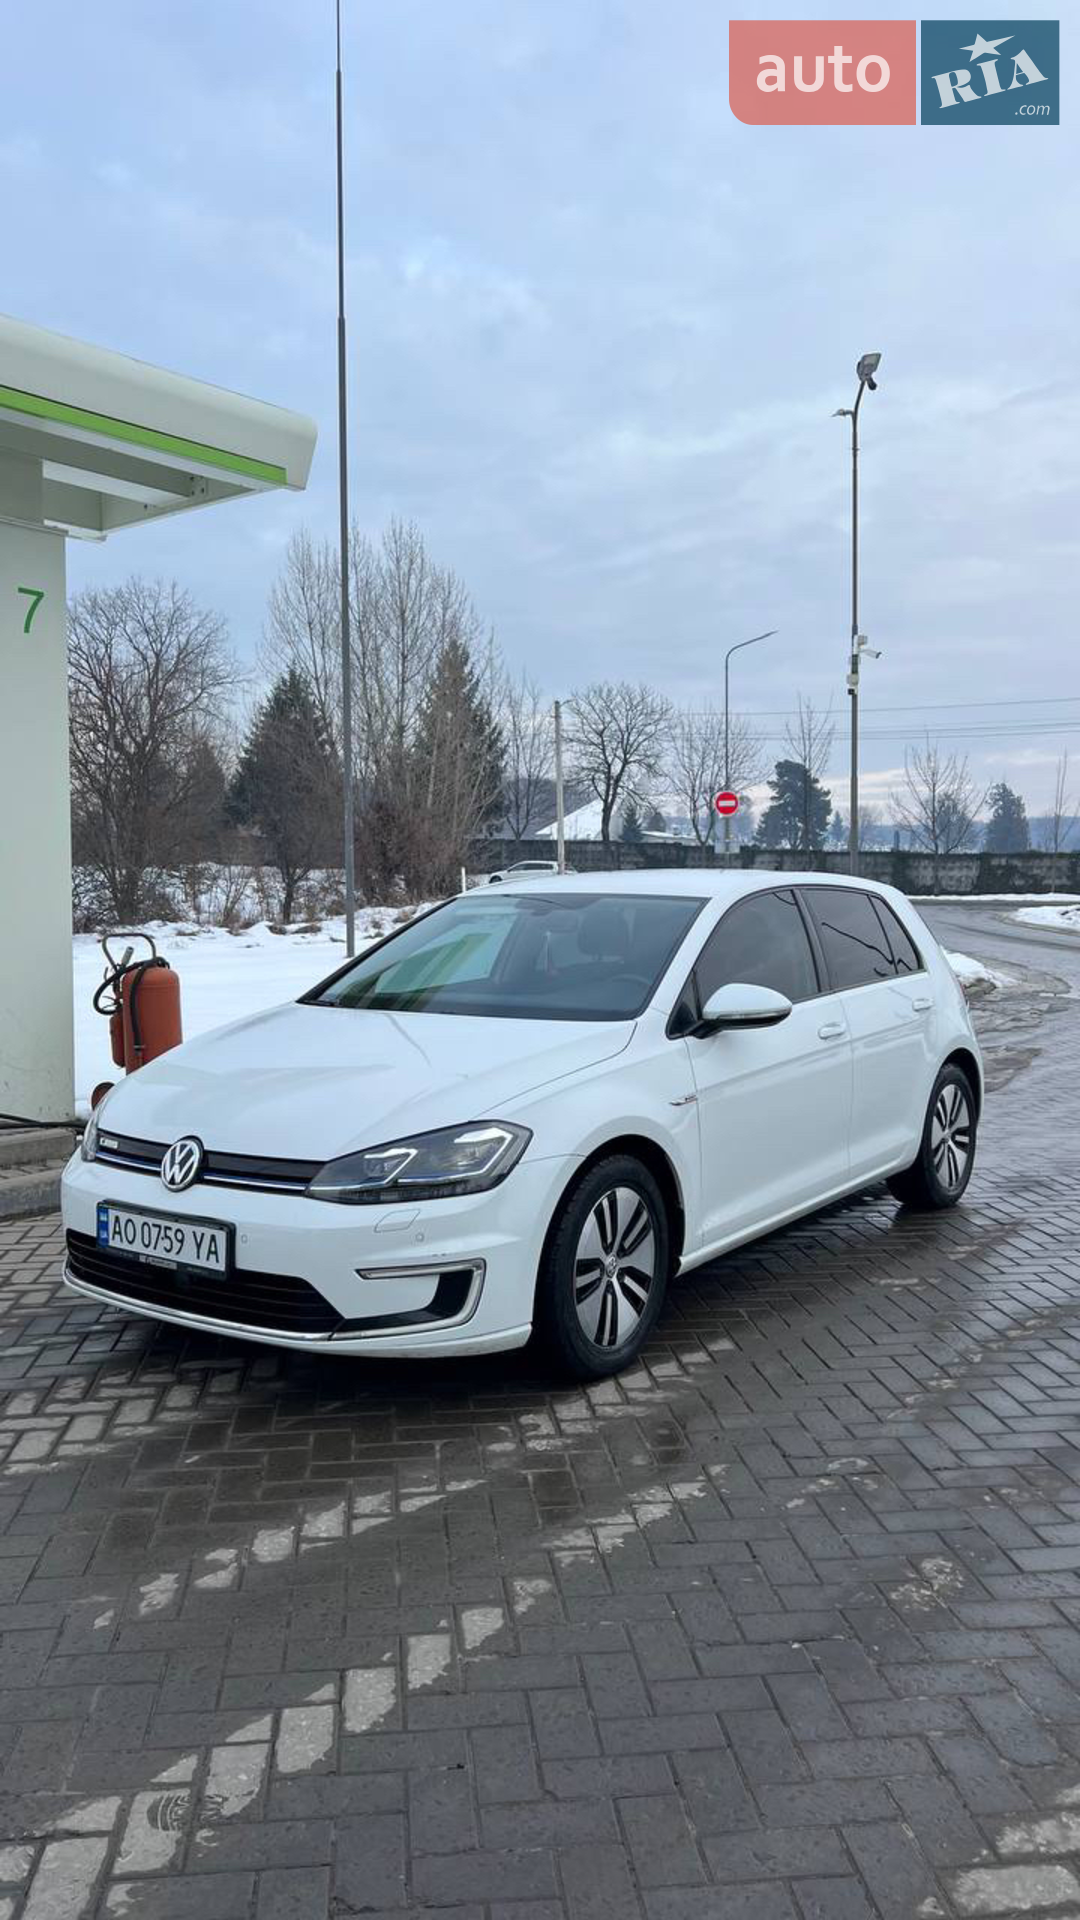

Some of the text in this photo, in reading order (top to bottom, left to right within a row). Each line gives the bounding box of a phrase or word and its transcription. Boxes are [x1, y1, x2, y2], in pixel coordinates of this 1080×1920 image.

[18, 587, 44, 633] 7
[112, 1215, 136, 1245] AO
[140, 1222, 185, 1256] 0759
[191, 1231, 220, 1264] YA
